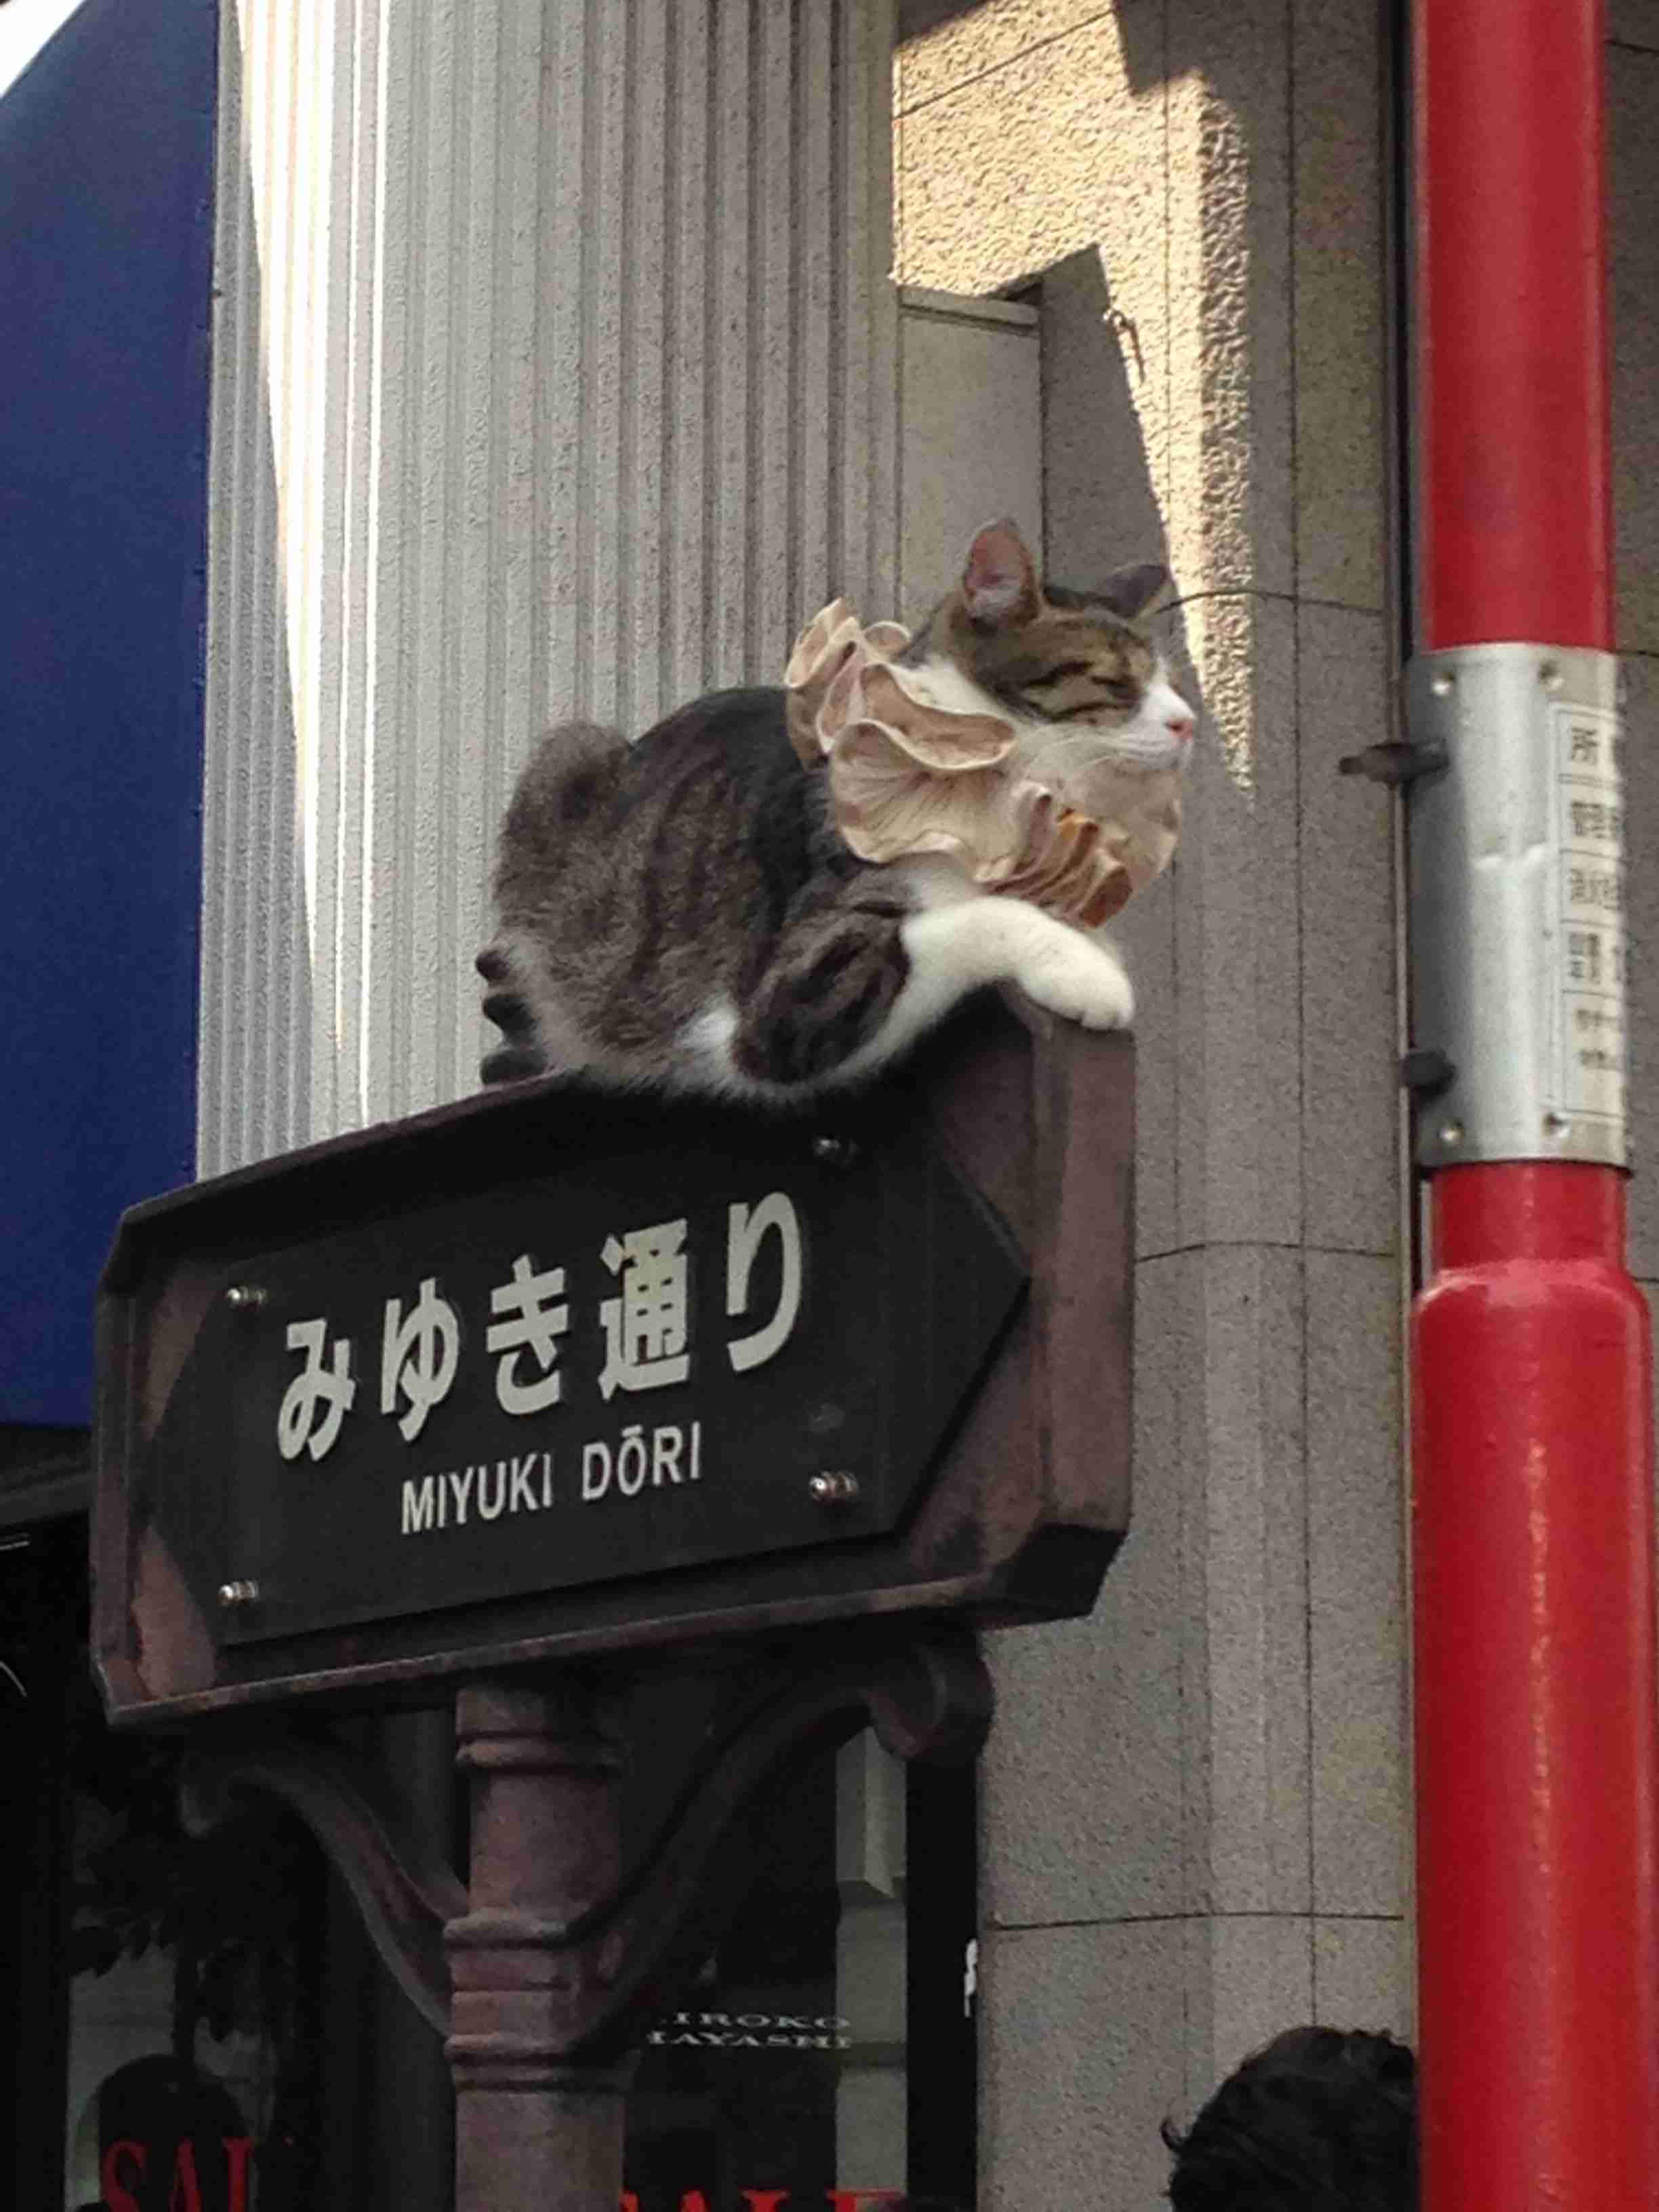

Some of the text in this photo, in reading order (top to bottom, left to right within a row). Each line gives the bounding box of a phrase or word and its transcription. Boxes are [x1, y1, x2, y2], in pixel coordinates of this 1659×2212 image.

[277, 1191, 802, 1461] みゆき通り
[401, 1421, 701, 1534] MIYUKI DŌRI
[661, 2011, 851, 2029] IROKO
